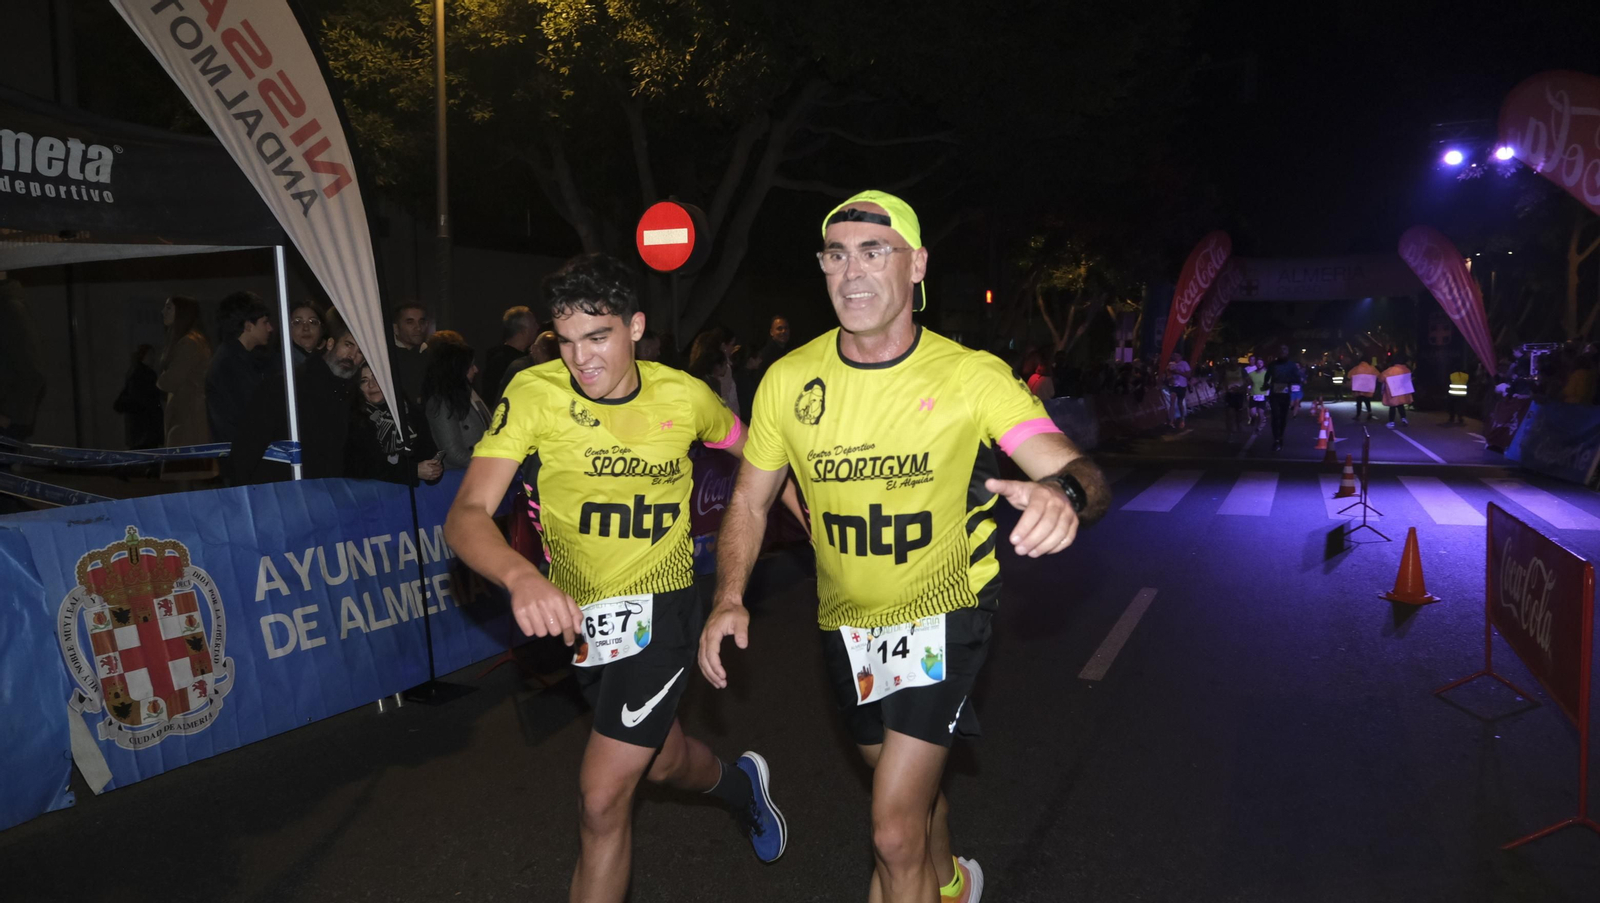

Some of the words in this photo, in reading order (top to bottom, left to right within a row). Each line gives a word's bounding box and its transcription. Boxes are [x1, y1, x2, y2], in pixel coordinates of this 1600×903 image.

[0, 175, 114, 204] deportivo
[1278, 265, 1366, 283] ALMERIA
[584, 447, 610, 458] Centro
[806, 449, 832, 462] Centro
[833, 443, 876, 456] Deportivo
[812, 452, 930, 482] SPORTGYM
[651, 477, 662, 485] El
[885, 480, 897, 491] El
[822, 503, 933, 565] mtp
[192, 571, 210, 587] DIDA
[208, 588, 218, 605] POR
[1499, 536, 1556, 658] Coca-Cola
[215, 609, 221, 620] LA
[585, 610, 632, 639] 657
[259, 603, 327, 660] DE
[595, 637, 623, 648] CARLITOS
[213, 624, 222, 664] LIBERTAD
[877, 635, 910, 664] 14
[66, 644, 84, 674] NOBLE
[82, 674, 99, 693] MUY
[128, 729, 163, 745] CIUDAD
[163, 723, 176, 732] DE
[176, 712, 213, 730] ALMERIA
